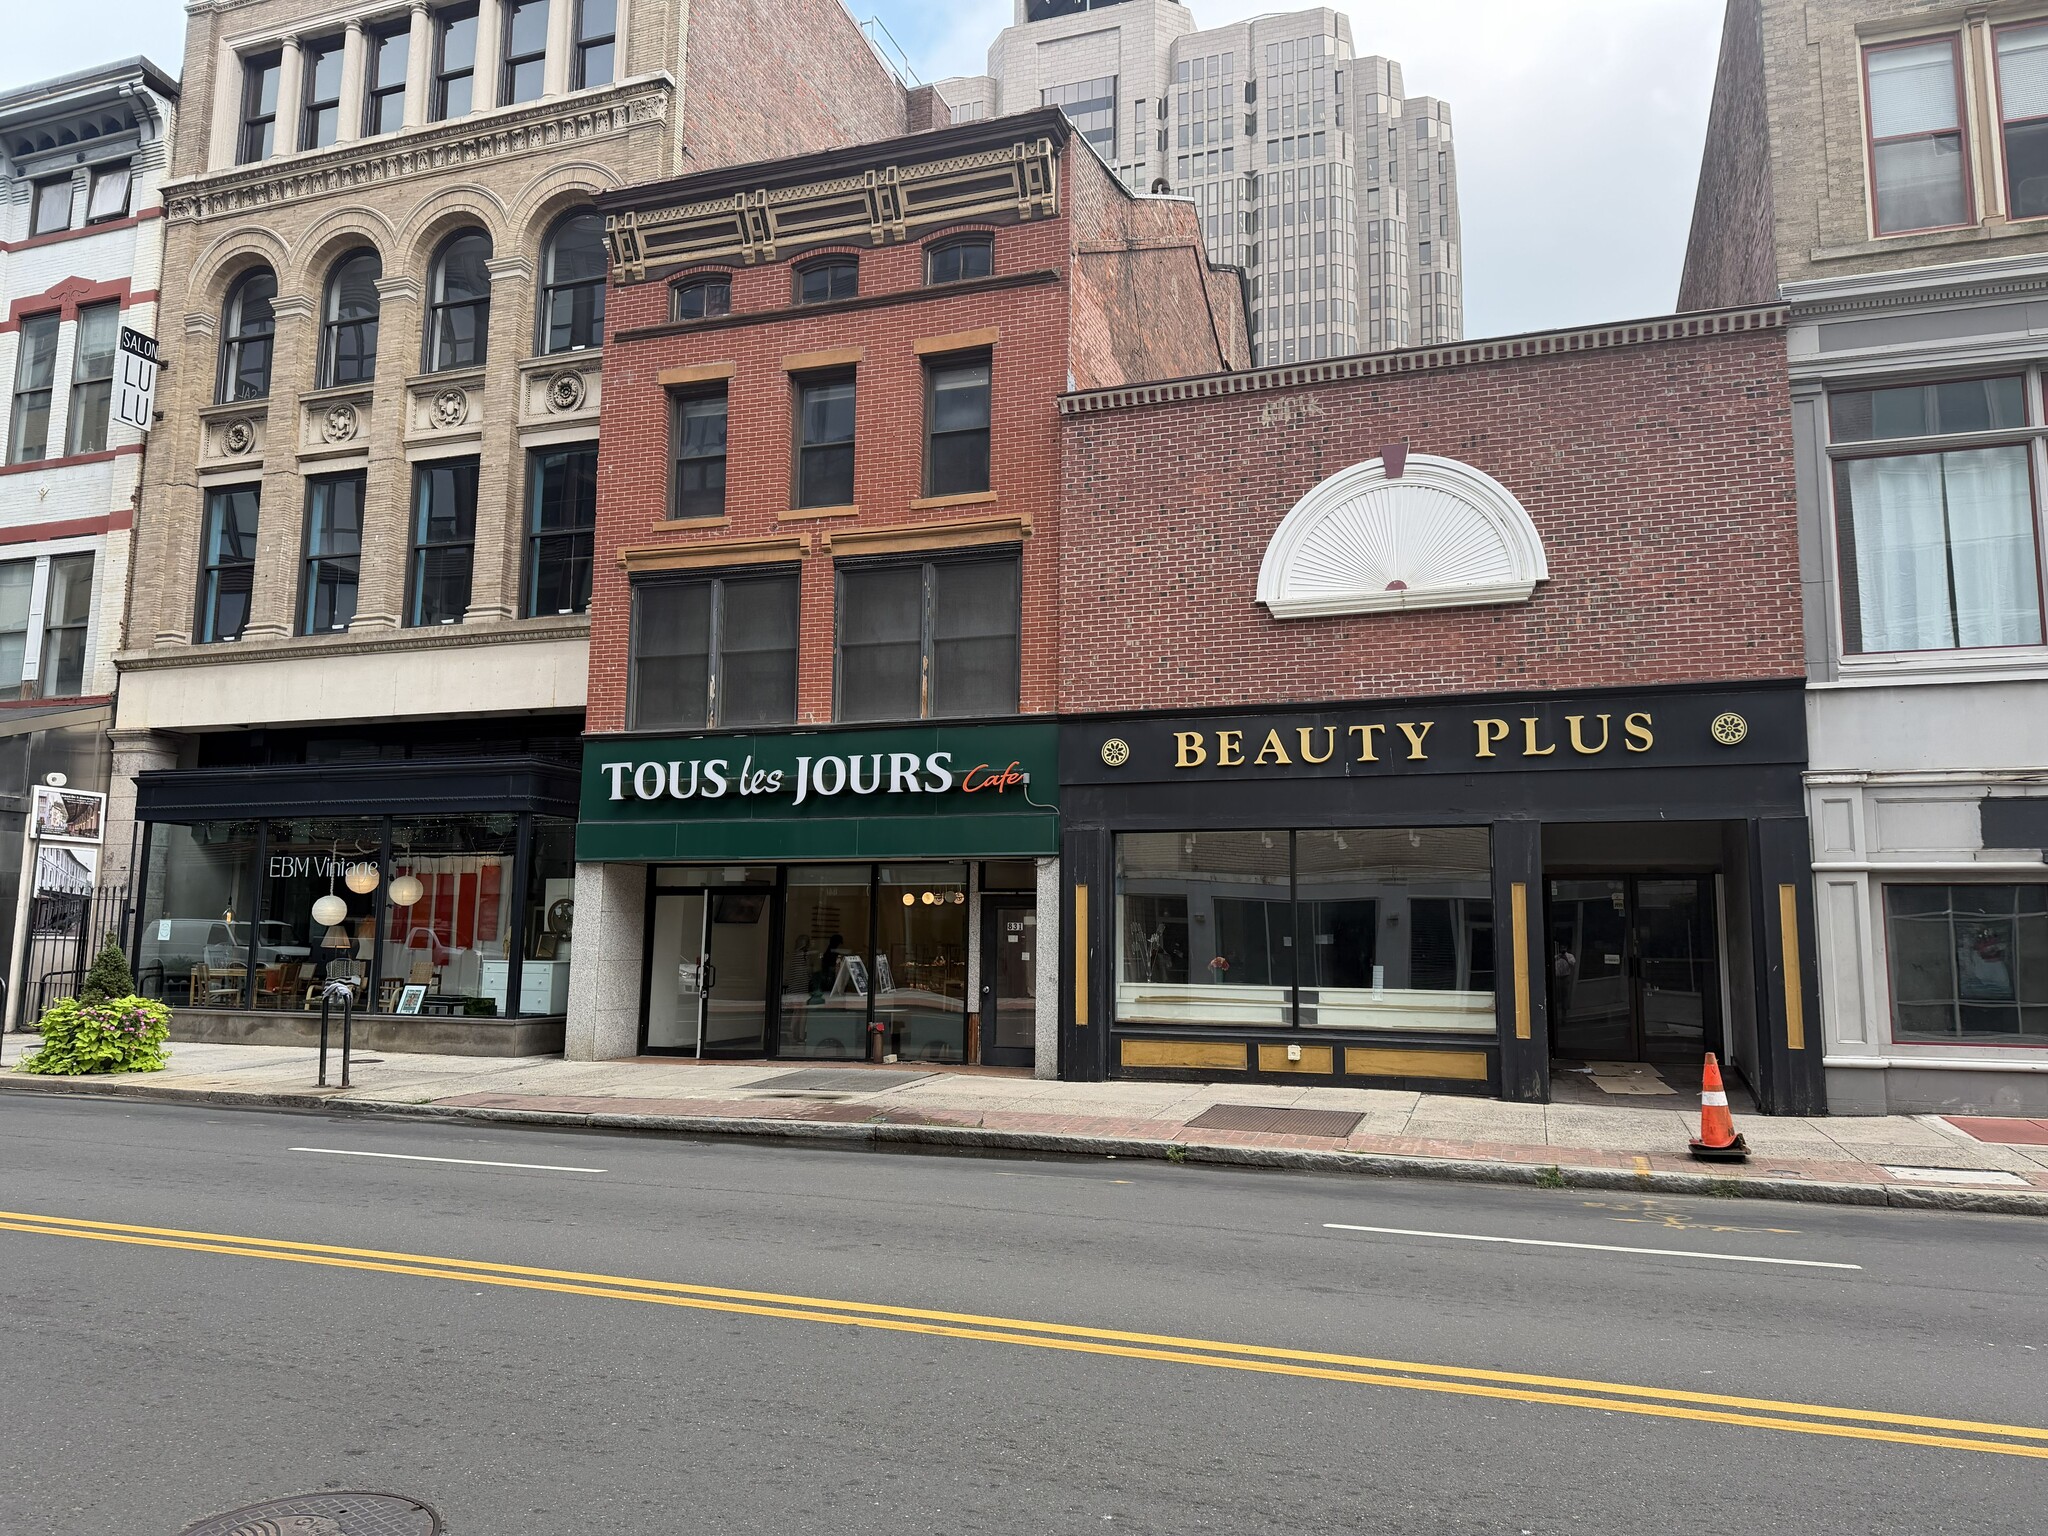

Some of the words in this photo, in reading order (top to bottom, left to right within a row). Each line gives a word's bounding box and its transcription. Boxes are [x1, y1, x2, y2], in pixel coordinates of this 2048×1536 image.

[123, 331, 158, 359] SALON
[124, 355, 152, 391] LU
[121, 389, 148, 425] LU
[1173, 721, 1434, 767] BEAUTY
[1473, 712, 1654, 758] PLUS
[601, 759, 728, 801] TOUS
[739, 755, 785, 796] les
[792, 752, 953, 806] JOURS
[962, 760, 1023, 793] Cafe
[269, 856, 310, 878] EBM
[313, 856, 378, 883] Vintage
[1007, 922, 1023, 931] 831
